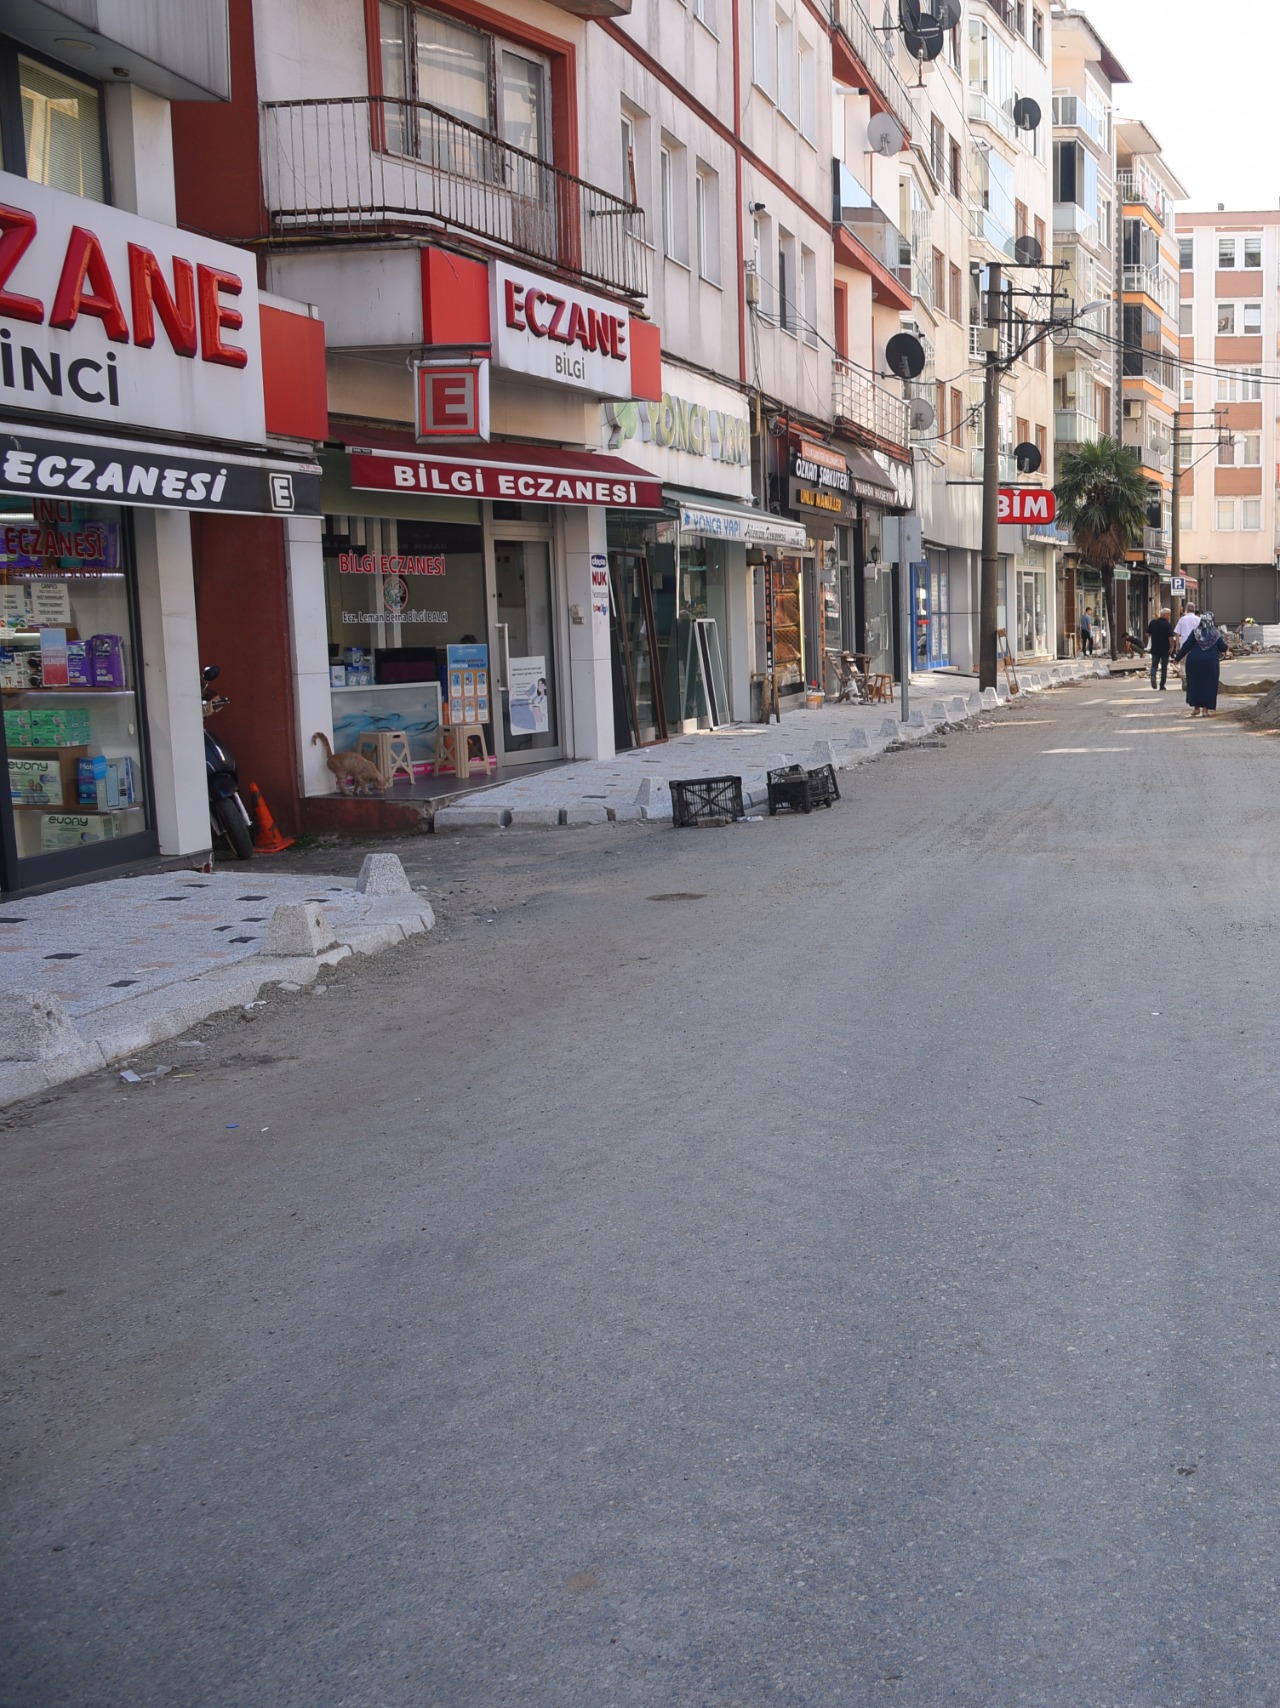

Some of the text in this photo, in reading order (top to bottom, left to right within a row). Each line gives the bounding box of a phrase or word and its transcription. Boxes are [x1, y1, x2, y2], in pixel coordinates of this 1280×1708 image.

[505, 278, 628, 362] ECZANE
[555, 353, 586, 381] BİLGİ
[431, 377, 468, 426] E
[3, 450, 228, 502] ECZANESİ
[795, 452, 818, 482] ÖZKAN
[393, 462, 637, 504] BİLGİ ECZANESİ
[693, 511, 722, 536] YONCA
[4, 526, 105, 560] ECZANESİ
[338, 549, 446, 576] BİLGİ ECZANESİ
[358, 611, 384, 623] Leman
[7, 760, 49, 772] evony
[48, 815, 89, 827] evony
